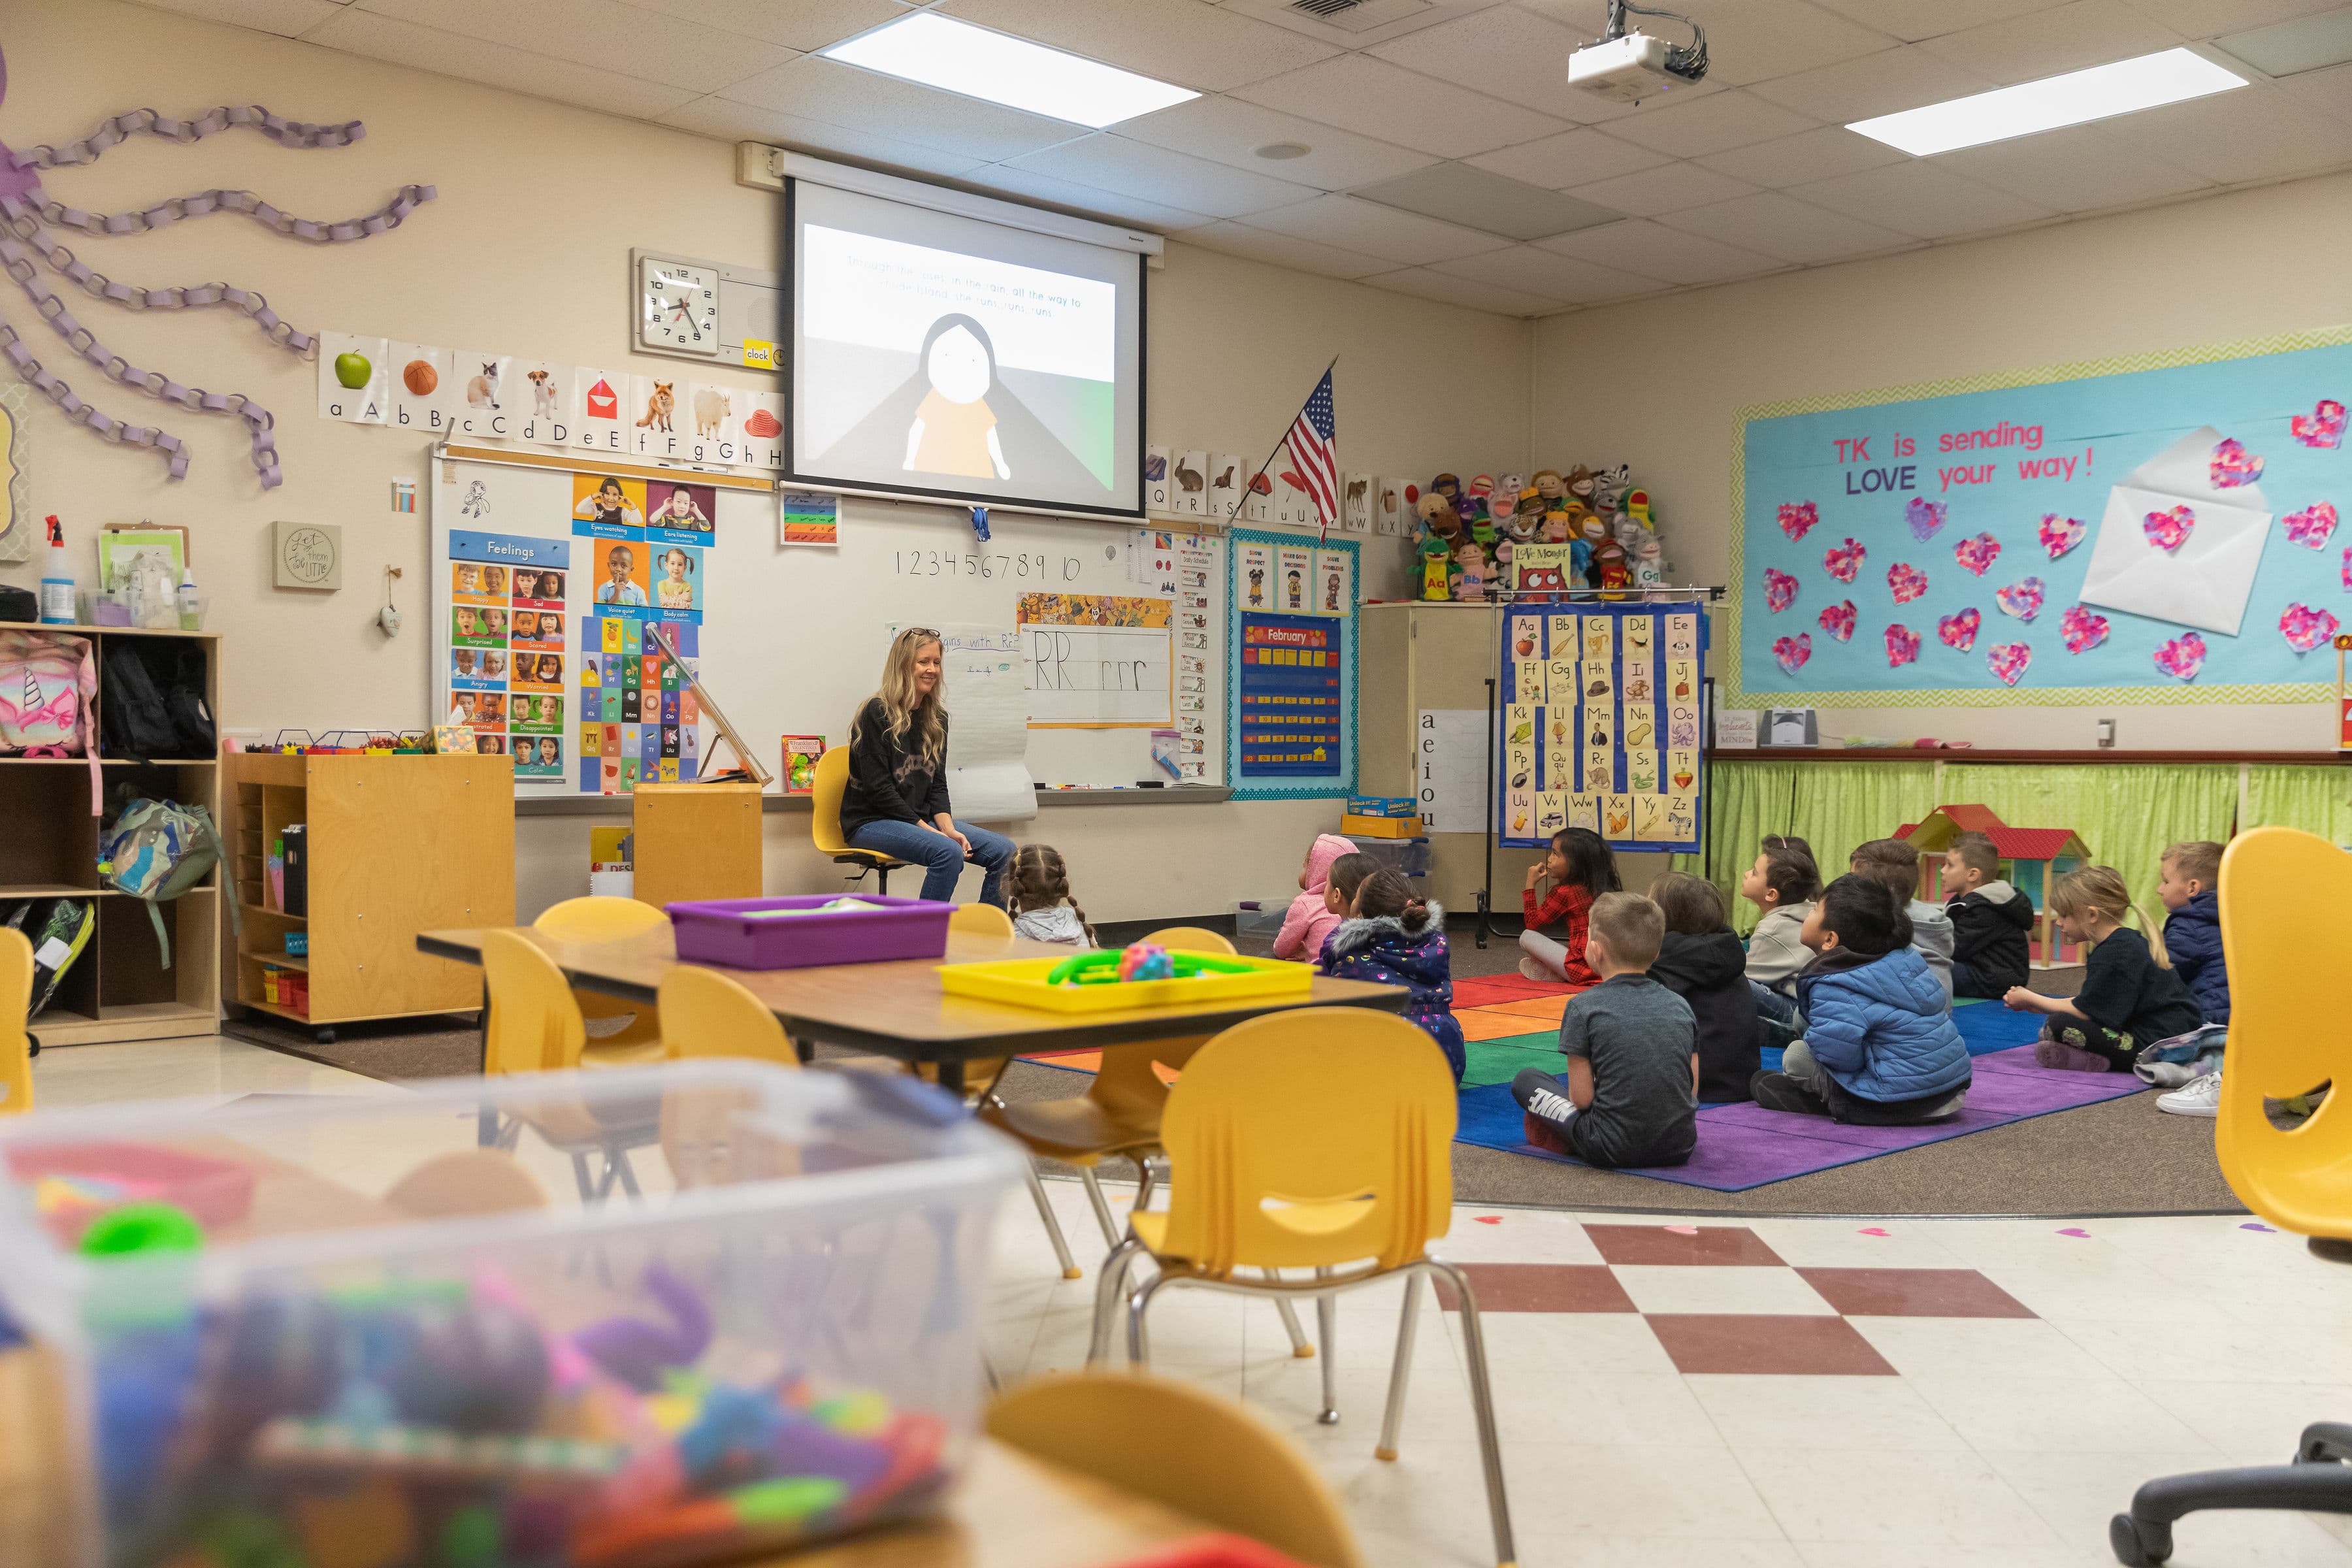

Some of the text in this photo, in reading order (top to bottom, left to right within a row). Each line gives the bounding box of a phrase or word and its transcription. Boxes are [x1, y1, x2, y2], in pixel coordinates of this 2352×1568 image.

[676, 269, 689, 278] 12
[651, 281, 663, 289] 10
[747, 348, 768, 360] clock
[331, 402, 380, 419] a A
[399, 404, 441, 427] b B
[463, 417, 506, 433] c C
[524, 420, 567, 441] d D
[584, 431, 619, 448] e E
[640, 434, 676, 453] f F
[1833, 421, 2044, 463] TK is sending
[694, 443, 733, 461] g G
[745, 445, 781, 466] h H
[1846, 465, 1916, 495] LOVE
[1939, 464, 1997, 493] your
[1154, 489, 1164, 503] Q
[1177, 498, 1197, 511] r R
[1213, 502, 1233, 514] s S
[1251, 504, 1266, 518] t T
[1281, 510, 1305, 521] u U
[1356, 517, 1366, 529] W
[1390, 521, 1395, 533] X
[604, 527, 627, 535] watching
[677, 531, 698, 541] listening
[291, 532, 325, 551] Let
[307, 551, 329, 561] them
[488, 541, 534, 561] Feelings
[897, 551, 1081, 581] 1 2 3 4 5 6 7 8 9 10
[1464, 575, 1480, 584] Bb
[1642, 570, 1659, 581] Gg
[1428, 578, 1445, 588] Aa
[1518, 619, 1534, 630] Aa
[1556, 619, 1569, 630] Bb
[1590, 619, 1604, 631] Cc
[1630, 619, 1646, 630] Dd
[1673, 617, 1688, 630] Ee
[467, 638, 493, 646] Surprised
[970, 634, 992, 647] with
[1268, 629, 1306, 644] February
[1524, 663, 1537, 675] Ff
[1552, 662, 1569, 679] Gg
[1589, 664, 1605, 675] Hh
[1632, 664, 1643, 676] Ii
[1676, 662, 1688, 681] Jj
[1514, 707, 1527, 719] Kk
[1588, 708, 1610, 720] Mm
[1631, 708, 1648, 720] Nn
[1673, 708, 1693, 719] Oo
[1514, 751, 1527, 768] Pp
[1552, 753, 1566, 763] Qu
[1592, 753, 1605, 764] Rr
[1637, 753, 1648, 765] Ss
[1675, 752, 1688, 764] Tt
[1421, 714, 1435, 826] a e i o u
[1554, 762, 1565, 772] qu
[1513, 794, 1527, 807] Uu
[1543, 794, 1558, 806] Vv
[1571, 796, 1593, 808] Ww
[1609, 796, 1625, 809] Xx
[1644, 797, 1656, 814] Yy
[1673, 798, 1686, 810] Zz
[1527, 1087, 1577, 1122] NIKE
